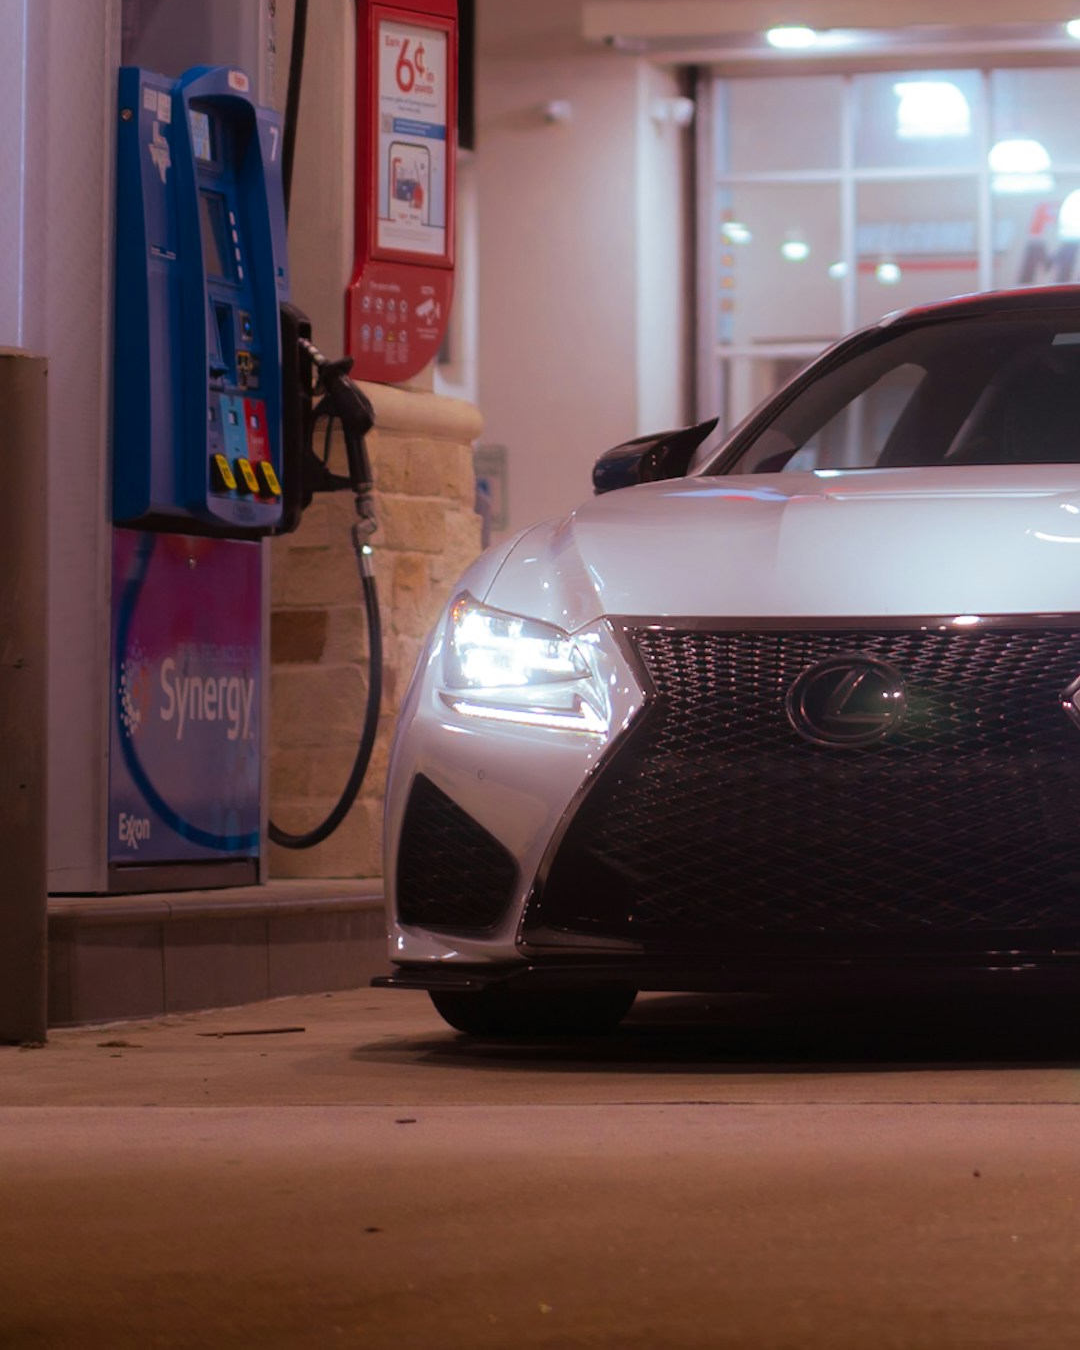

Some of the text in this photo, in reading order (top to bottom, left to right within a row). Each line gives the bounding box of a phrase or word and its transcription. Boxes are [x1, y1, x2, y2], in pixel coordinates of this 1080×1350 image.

[269, 126, 279, 162] 7
[160, 657, 254, 740] Synergy
[118, 812, 151, 849] Exxon
